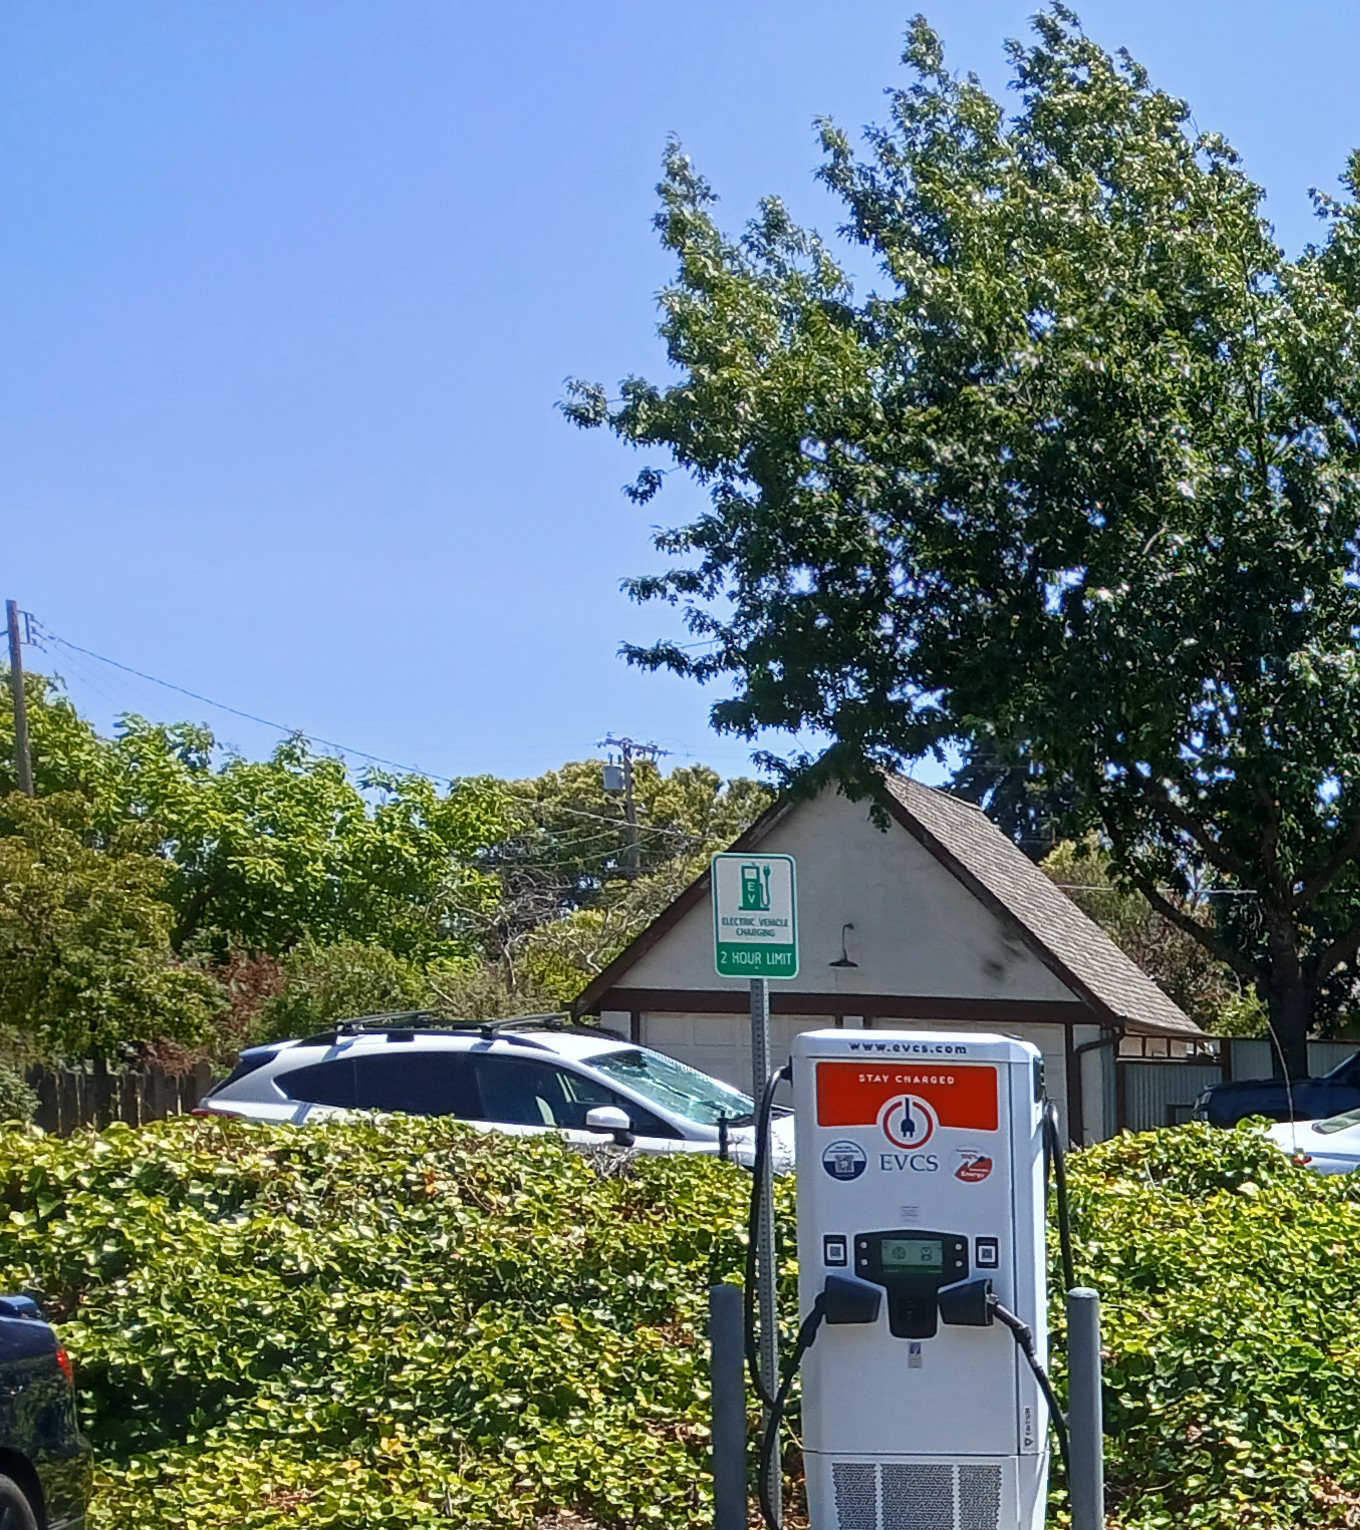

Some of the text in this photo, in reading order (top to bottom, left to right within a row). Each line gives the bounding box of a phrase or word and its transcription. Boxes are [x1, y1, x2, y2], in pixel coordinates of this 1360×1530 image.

[747, 882, 756, 904] EV
[721, 917, 789, 927] ELECTRIC VEHICLE
[735, 928, 776, 937] CHARGING
[720, 951, 793, 965] 2 HOUR LIMIT
[849, 1042, 967, 1055] www.evcs.com
[858, 1074, 955, 1085] STAY CHARGED
[879, 1154, 939, 1172] EVCS
